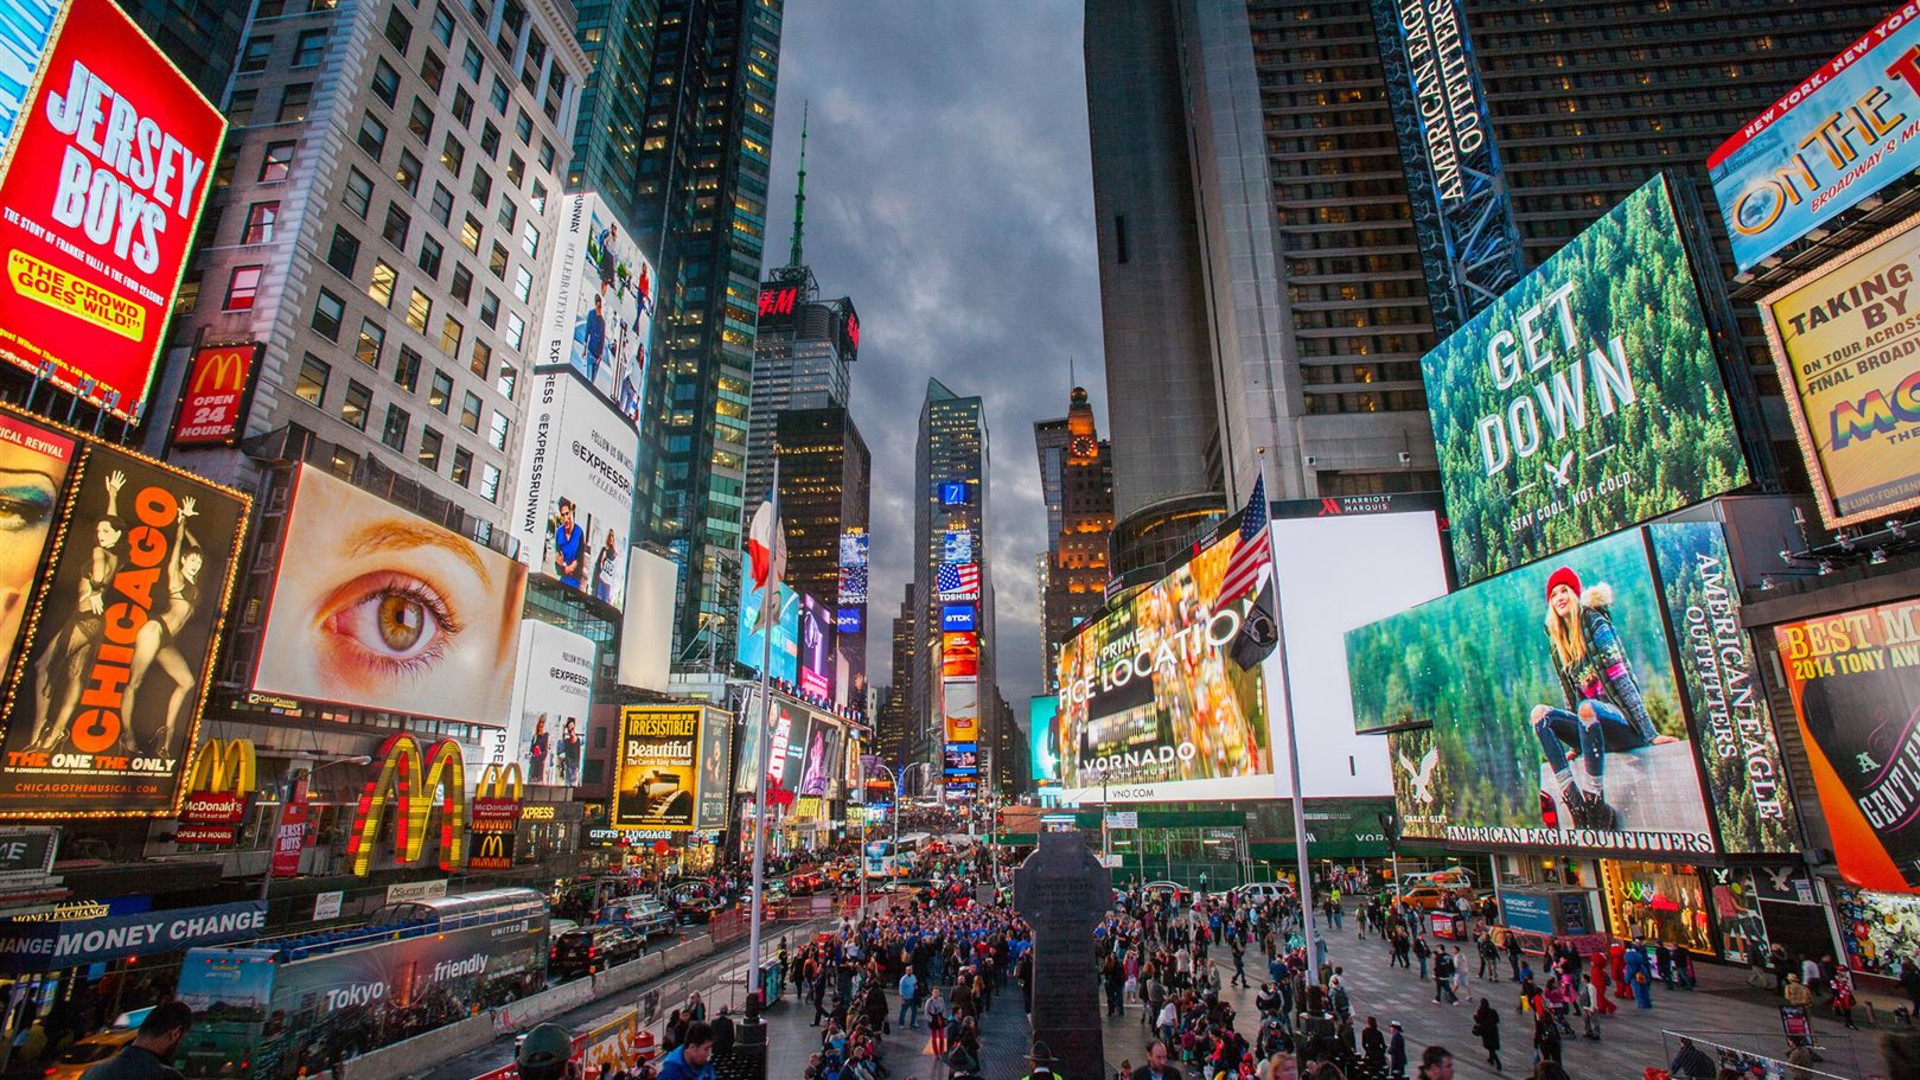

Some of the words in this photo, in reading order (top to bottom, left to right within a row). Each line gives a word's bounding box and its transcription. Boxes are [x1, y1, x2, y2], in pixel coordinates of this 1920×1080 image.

[1745, 109, 1775, 138] NEW
[1779, 74, 1828, 110] YORK,
[1832, 37, 1871, 72] NEW
[47, 60, 204, 219] JERSEY
[1413, 59, 1465, 200] AMERICAN
[1732, 153, 1820, 235] ON
[1797, 85, 1907, 170] THE
[1811, 138, 1898, 213] BROADWAY'S
[52, 145, 167, 273] BOYS
[569, 193, 584, 234] RUNWAY
[4, 207, 19, 225] THE
[20, 217, 45, 239] STORY
[46, 231, 56, 244] OF
[56, 237, 86, 262] FRANKIE
[86, 252, 103, 273] VALLI
[104, 265, 110, 276] &
[110, 269, 123, 282] THE
[123, 275, 139, 291] FOUR
[18, 272, 76, 305] GOES
[71, 277, 138, 319] CROWD
[1788, 263, 1914, 336] TAKING
[1861, 289, 1910, 330] BY
[1486, 280, 1578, 390] GET
[1802, 360, 1821, 376] ON
[1823, 341, 1862, 367] TOUR
[1865, 313, 1920, 349] ACROSS
[1808, 368, 1854, 396] FINAL
[193, 394, 235, 406] OPEN
[193, 406, 227, 424] 24
[1477, 336, 1636, 477] DOWN
[0, 426, 22, 444] ICAL
[25, 436, 63, 458] REVIVAL
[180, 425, 231, 437] HOURS
[524, 413, 550, 534] @EXPRESSRUNWAY
[949, 485, 959, 500] 7
[1344, 496, 1392, 504] MARRIOTT
[1511, 516, 1532, 532] STAY
[1572, 486, 1595, 506] NOT
[939, 593, 977, 601] TOSHIBA
[71, 487, 178, 753] CHICAGO
[1103, 626, 1145, 661] PRIME
[1784, 614, 1872, 660] BEST
[1793, 657, 1835, 680] 2014
[1837, 650, 1885, 675] TONY
[1686, 606, 1738, 759] OUTFITTERS
[1696, 552, 1756, 715] AMERICAN
[1737, 715, 1784, 819] EAGLE
[7, 752, 49, 767] THE
[52, 754, 93, 769] ONE
[94, 755, 129, 770] THE
[131, 757, 176, 772] ONLY
[628, 740, 693, 757] Beautiful
[1084, 742, 1196, 774] VORNADO
[1856, 751, 1881, 773] A
[15, 783, 158, 794] CHICAGOTHEMUSICAL.COM
[1112, 789, 1154, 798] VNO.COM
[183, 799, 242, 814] McDonald's
[474, 803, 519, 811] McDonald's
[521, 807, 555, 820] XPRESS
[208, 831, 232, 839] HOURS
[278, 823, 307, 838] JERSEY
[280, 837, 301, 851] BOYS
[590, 830, 618, 838] GIFTS
[625, 830, 671, 839] LUGGAGE
[1448, 826, 1525, 844] AMERICAN
[1527, 827, 1577, 846] EAGLE
[1581, 830, 1713, 853] OUTFITTERS
[11, 912, 51, 922] MONEY
[51, 903, 110, 920] EXCHANGE
[54, 923, 164, 957] MONEY
[170, 910, 267, 940] CHANGE
[491, 924, 520, 936] UNITED
[327, 981, 385, 1011] Tokyo
[435, 953, 488, 982] friendly
